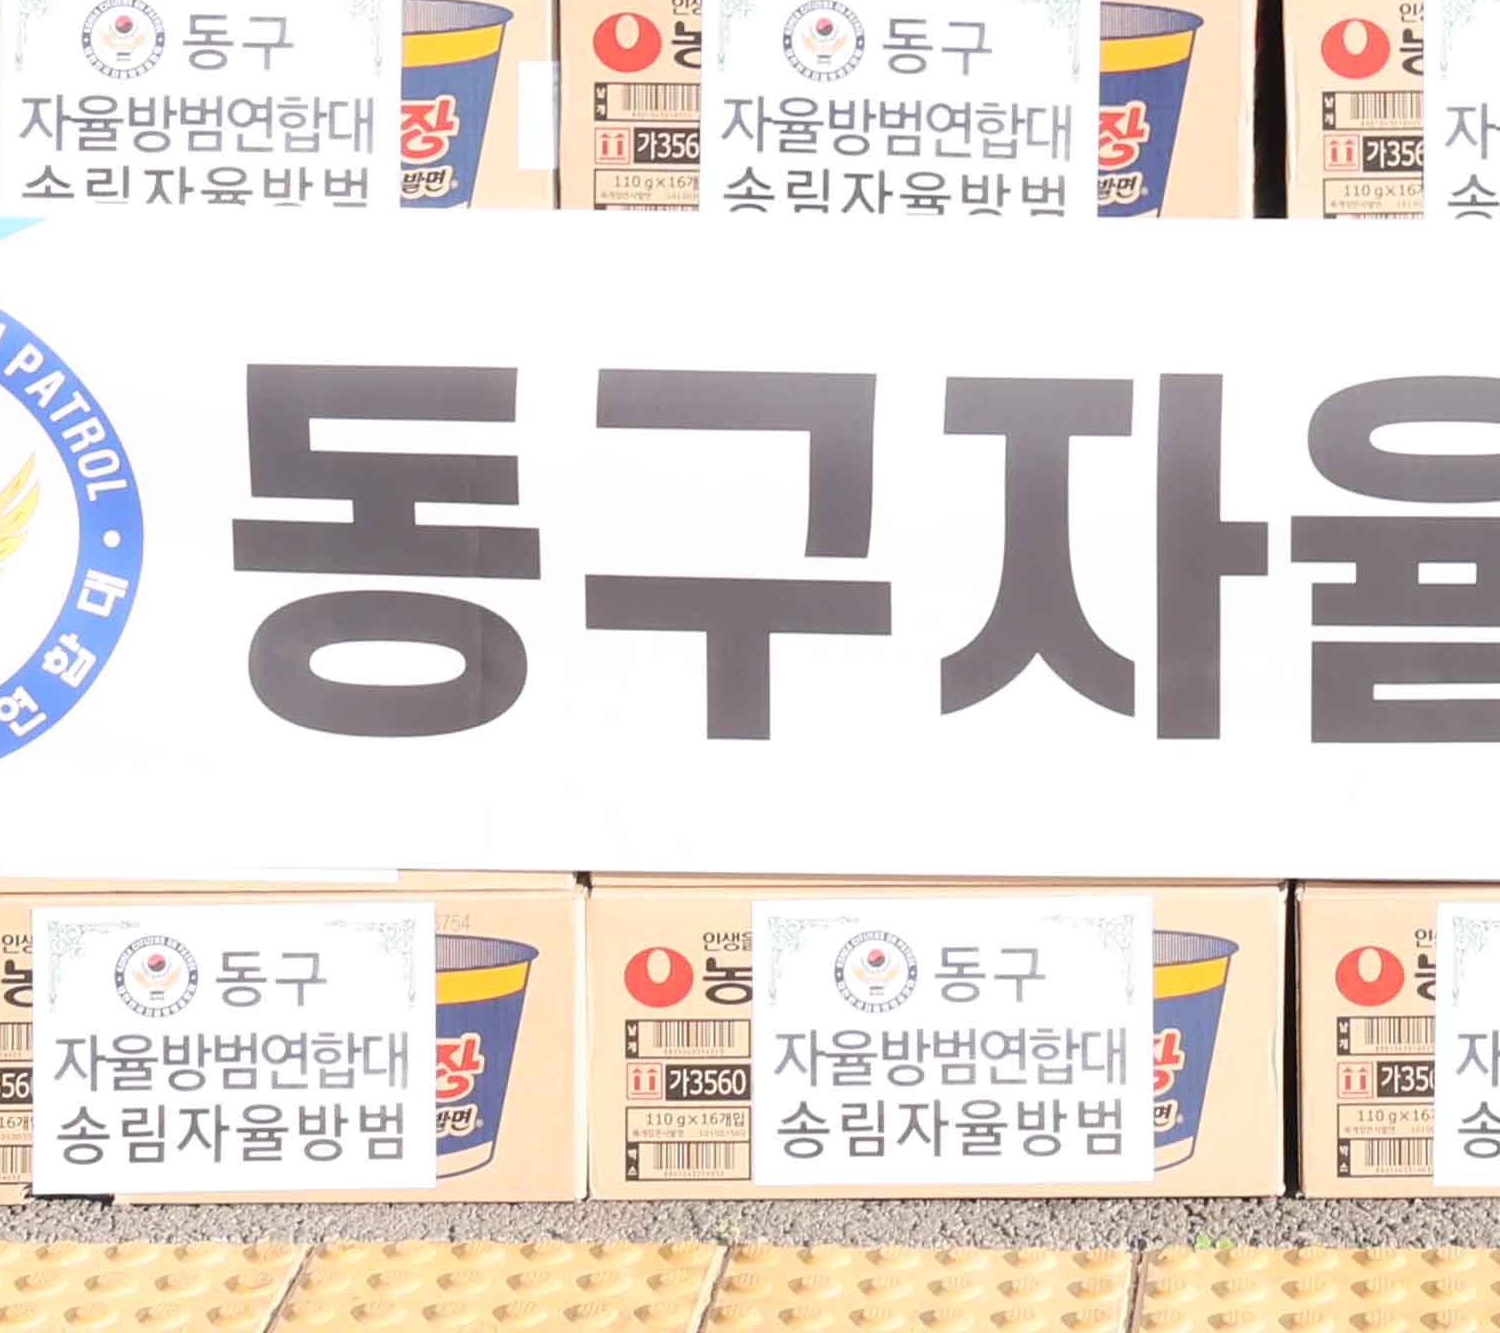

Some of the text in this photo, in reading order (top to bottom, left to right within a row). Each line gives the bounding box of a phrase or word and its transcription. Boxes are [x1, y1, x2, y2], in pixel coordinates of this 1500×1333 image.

[182, 13, 295, 72] 동구
[882, 16, 993, 76] 동구
[19, 95, 376, 155] 자율방범연합대
[720, 95, 1073, 161] 자율방범연합대
[3, 346, 129, 502] PATROL
[215, 951, 328, 1007] 동구
[933, 947, 1046, 1004] 동구
[53, 1033, 410, 1092] 자율방범연합대
[670, 1069, 746, 1097] 가3560
[774, 1029, 1127, 1086] 자율방범연합대
[56, 1103, 404, 1164] 송림자율방범
[776, 1099, 1123, 1159] 송림자율방범
